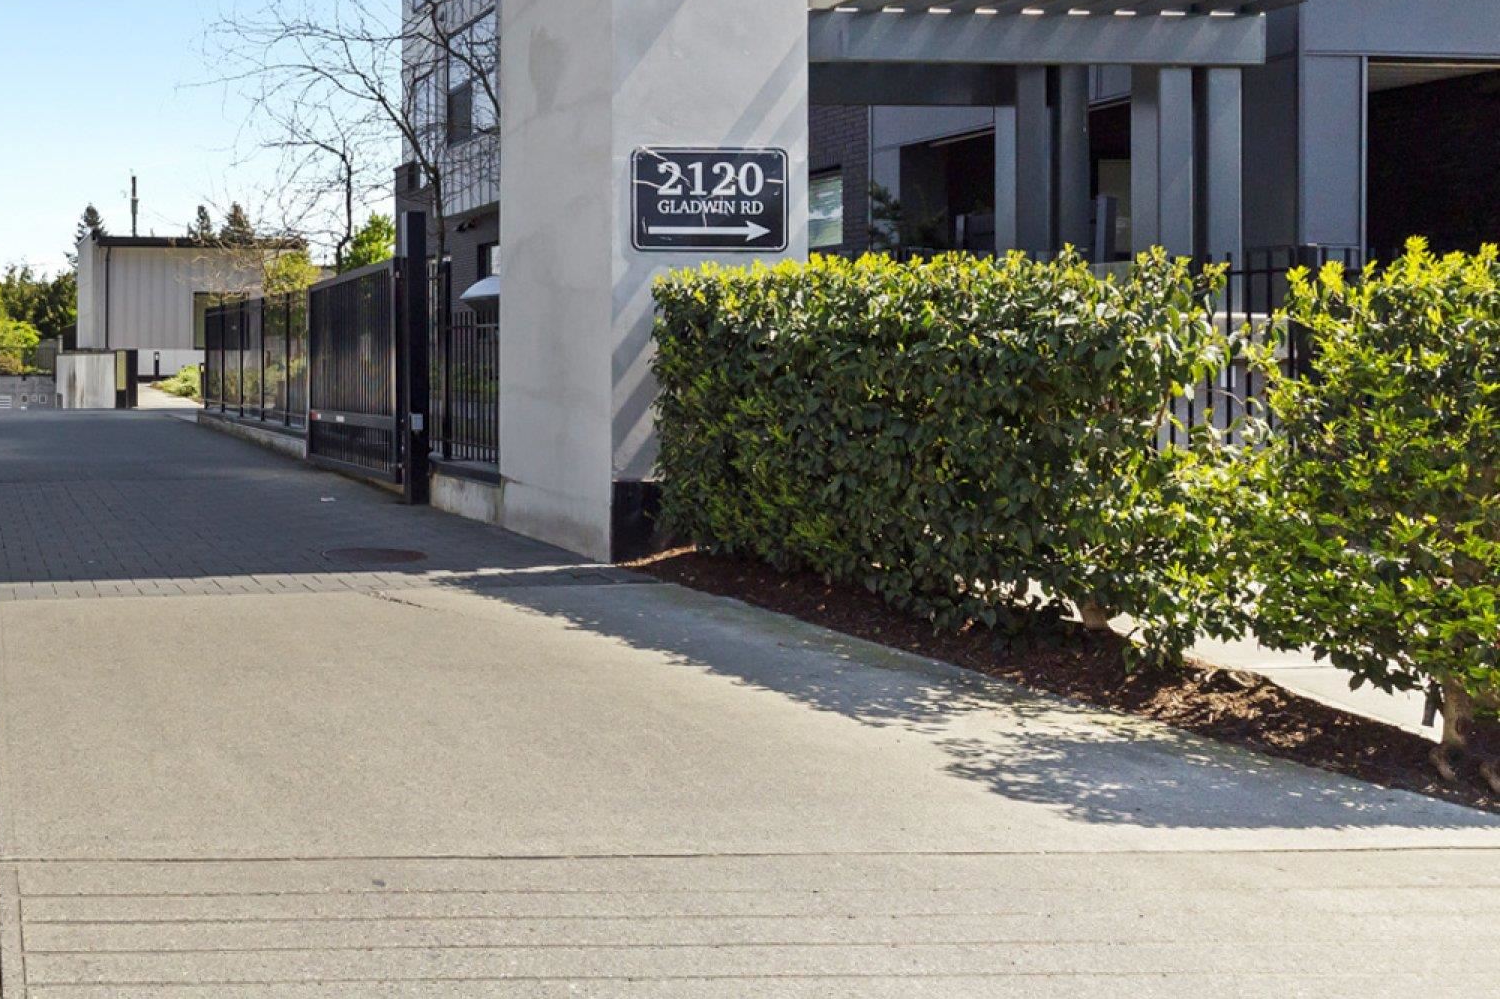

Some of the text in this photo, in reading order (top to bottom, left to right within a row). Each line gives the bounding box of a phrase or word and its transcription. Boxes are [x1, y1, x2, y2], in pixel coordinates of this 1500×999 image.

[657, 162, 764, 196] 2120
[657, 200, 764, 215] GLADWIN RD
